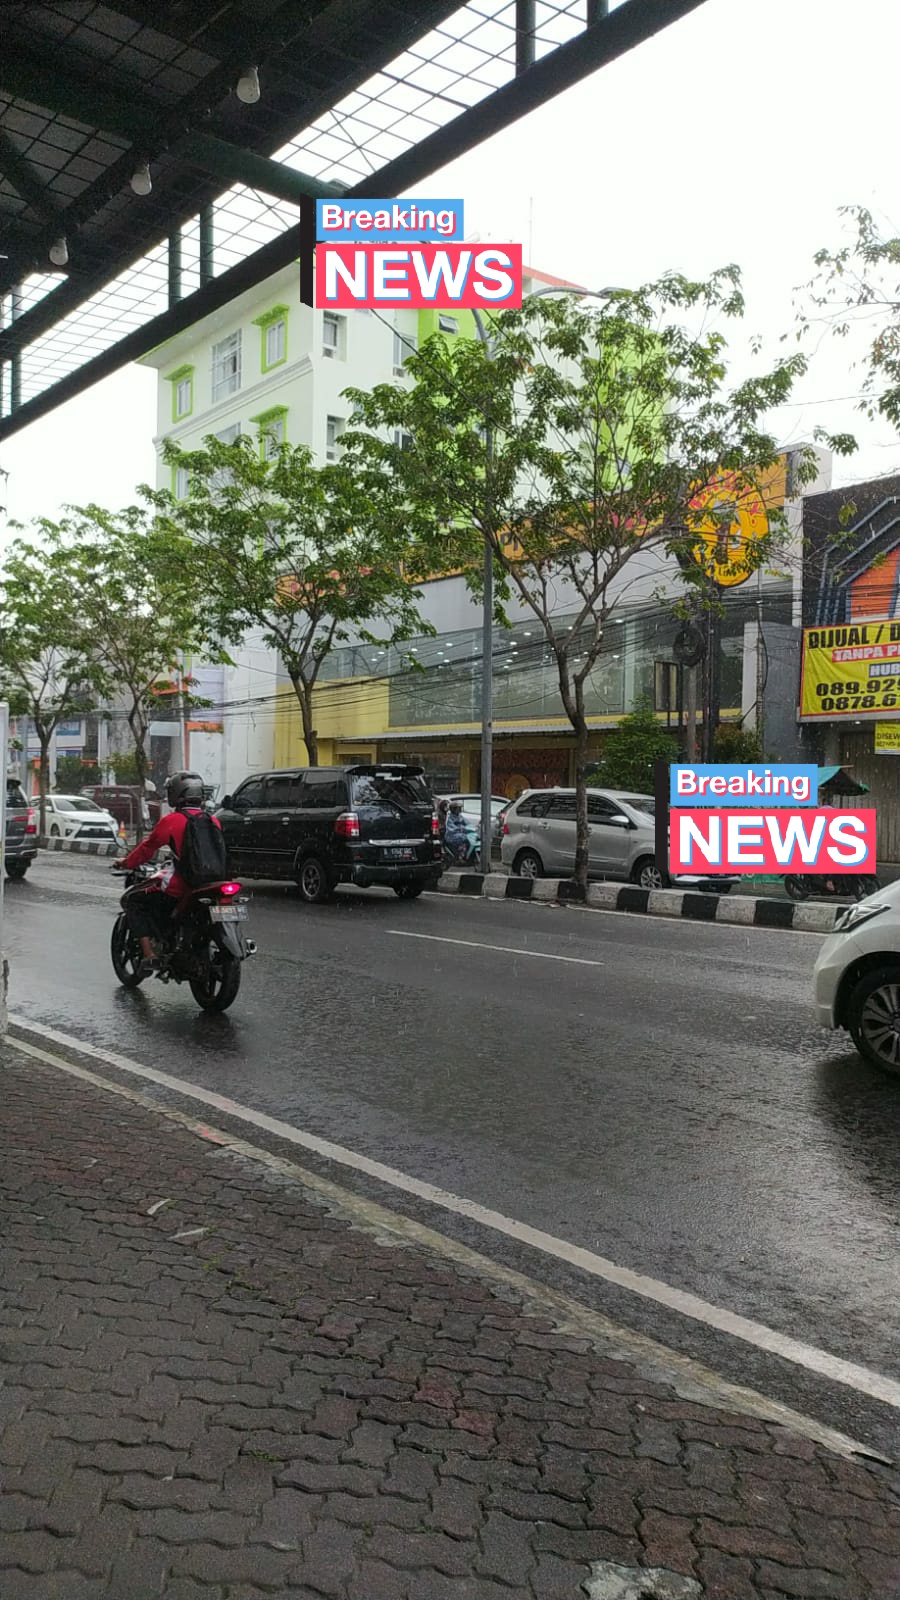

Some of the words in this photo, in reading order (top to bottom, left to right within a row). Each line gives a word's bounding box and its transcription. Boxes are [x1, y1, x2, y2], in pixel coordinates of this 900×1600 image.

[808, 626, 870, 649] DIJUAL
[834, 647, 884, 661] TANPA
[821, 693, 900, 711] 0878.6
